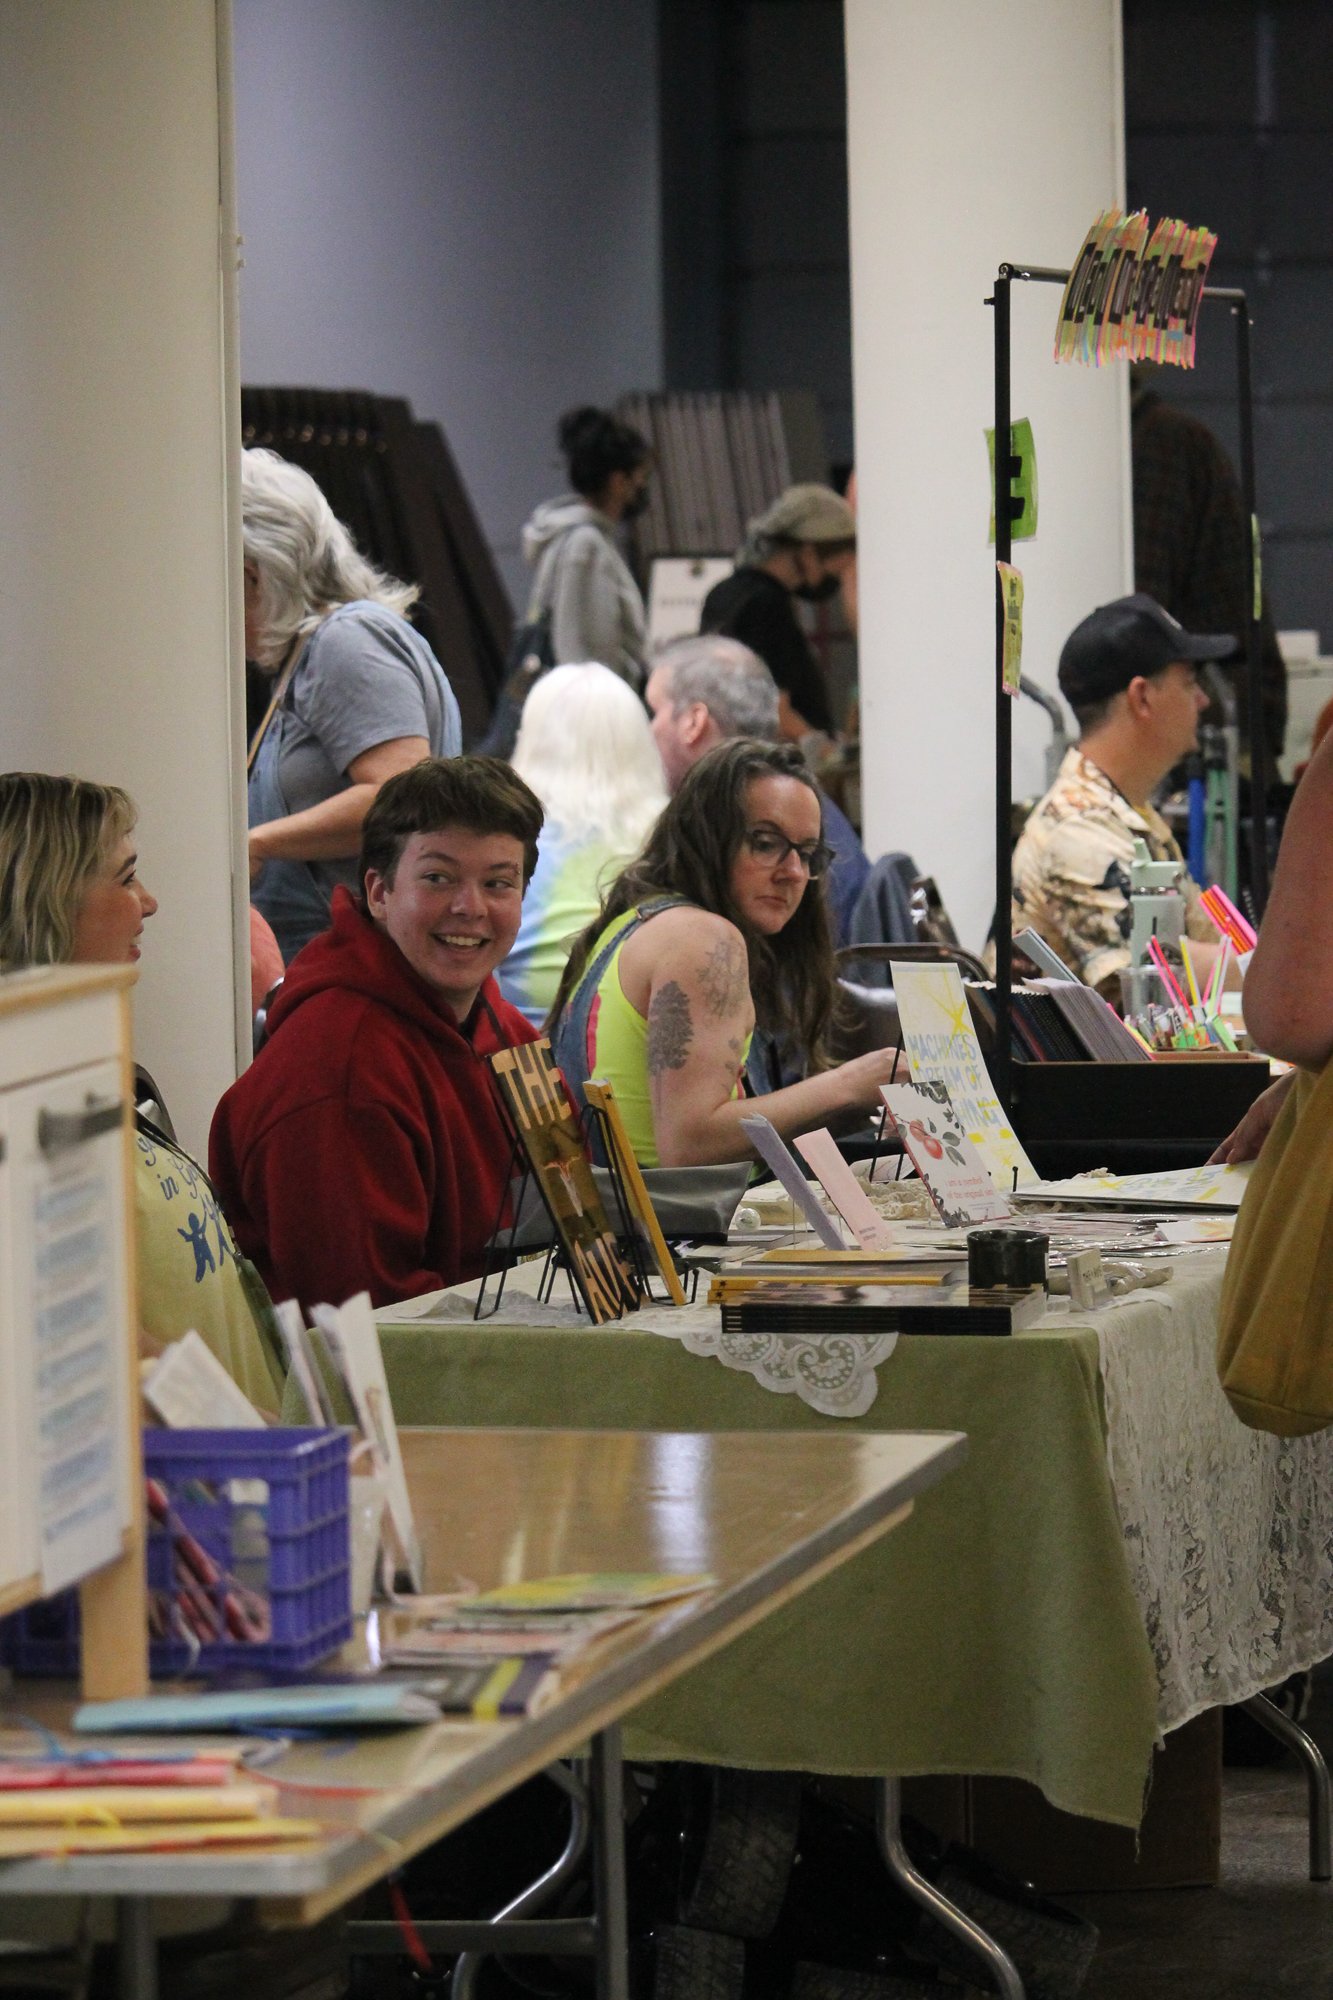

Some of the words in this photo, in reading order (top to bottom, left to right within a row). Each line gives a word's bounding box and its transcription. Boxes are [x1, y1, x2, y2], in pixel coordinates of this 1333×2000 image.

[907, 1033, 977, 1061] MACHINES
[490, 1037, 572, 1130] THE
[965, 1064, 983, 1091] OF
[157, 1174, 179, 1200] in
